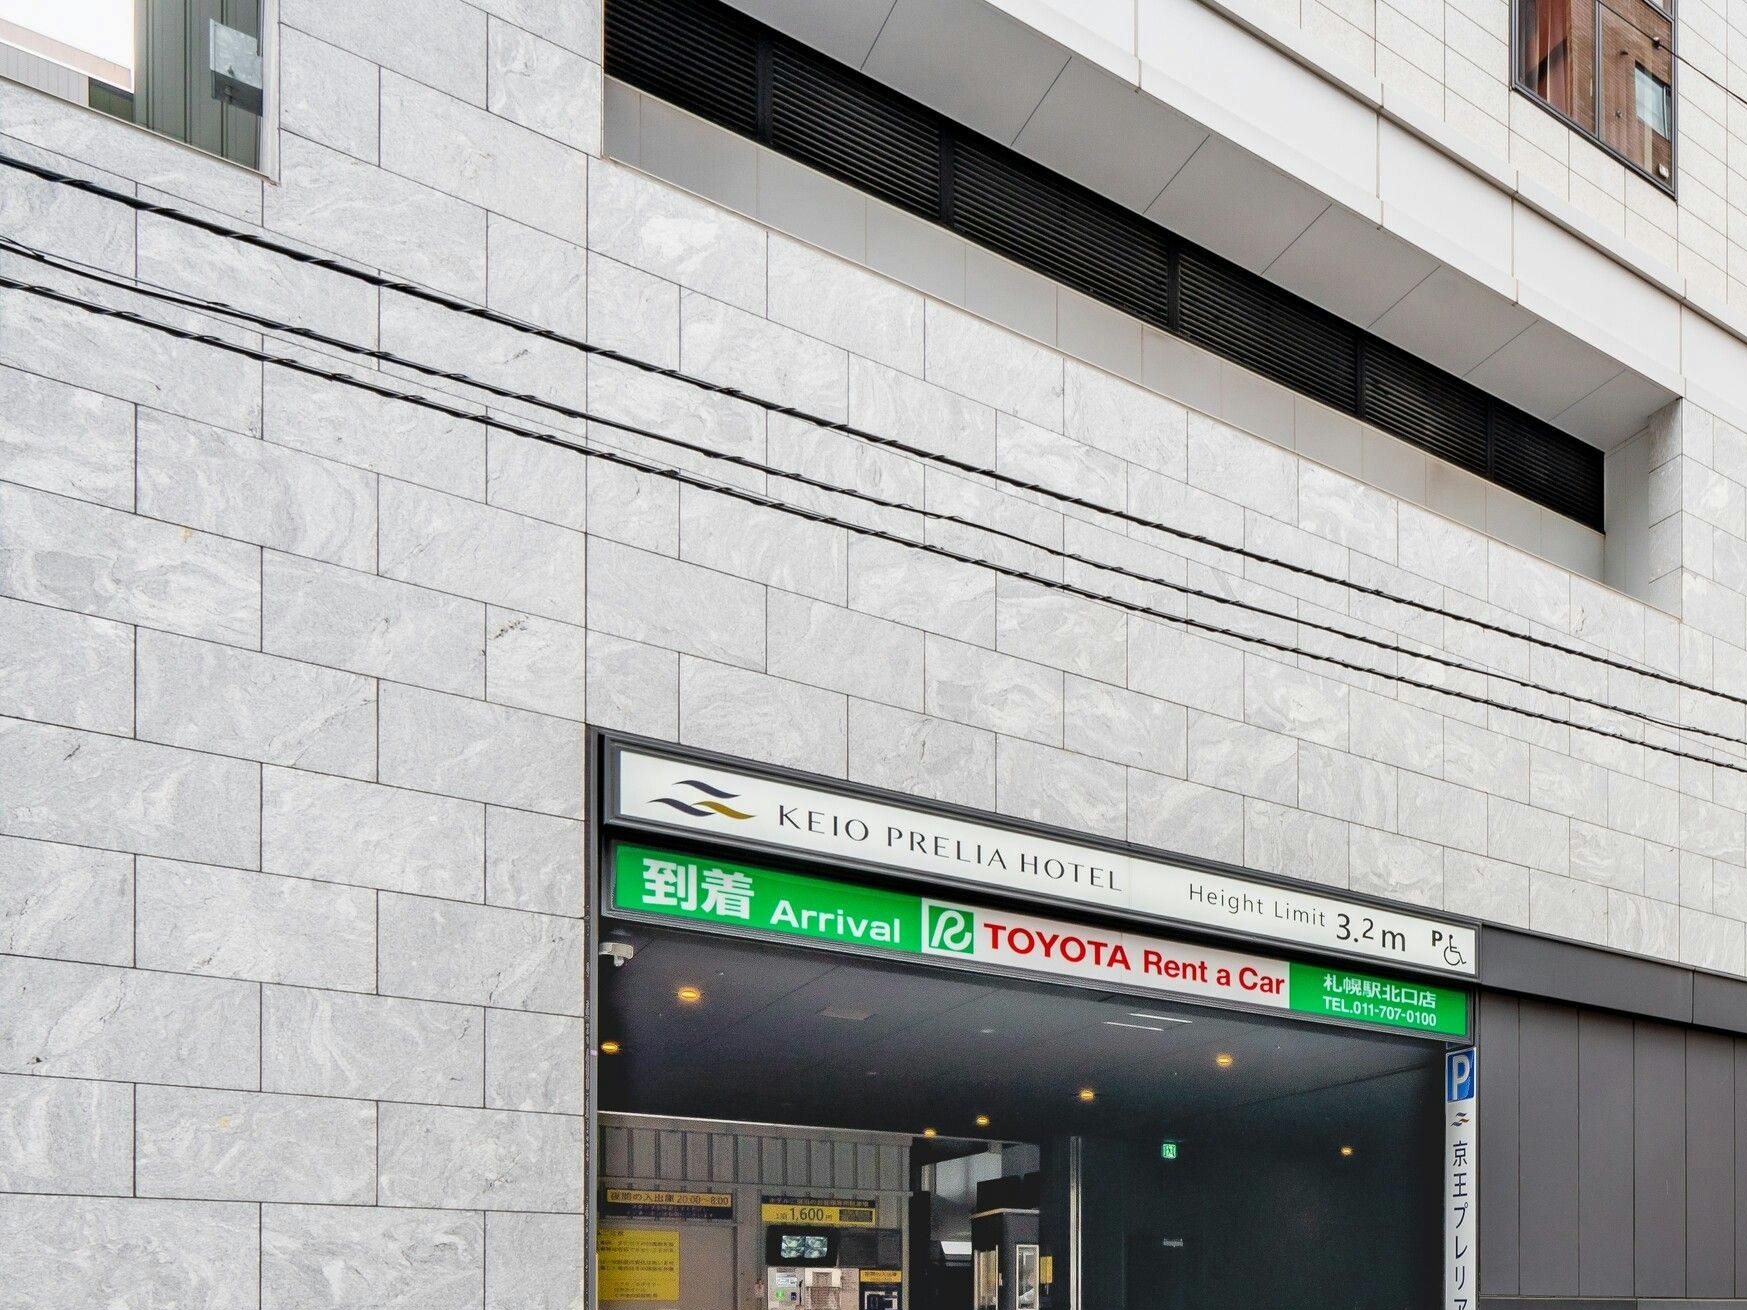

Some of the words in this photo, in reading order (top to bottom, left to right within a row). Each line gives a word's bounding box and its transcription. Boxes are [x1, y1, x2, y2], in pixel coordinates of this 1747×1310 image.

[778, 805, 870, 842] KEIO
[887, 826, 1008, 870] PRELIA
[1020, 853, 1123, 892] HOTEL
[642, 857, 755, 921] 到着
[769, 899, 901, 944] Arrival
[1189, 883, 1264, 915] Height
[1274, 901, 1327, 928] Limit
[983, 923, 1131, 971] TOYOTA
[1143, 949, 1208, 983] Rent
[1216, 968, 1231, 988] a
[1239, 967, 1285, 996] Car
[1431, 930, 1443, 947] P
[1322, 995, 1437, 1027] TEL.011-707-0100
[1323, 973, 1437, 1009] 札幌駅北口店
[1450, 1055, 1471, 1100] P
